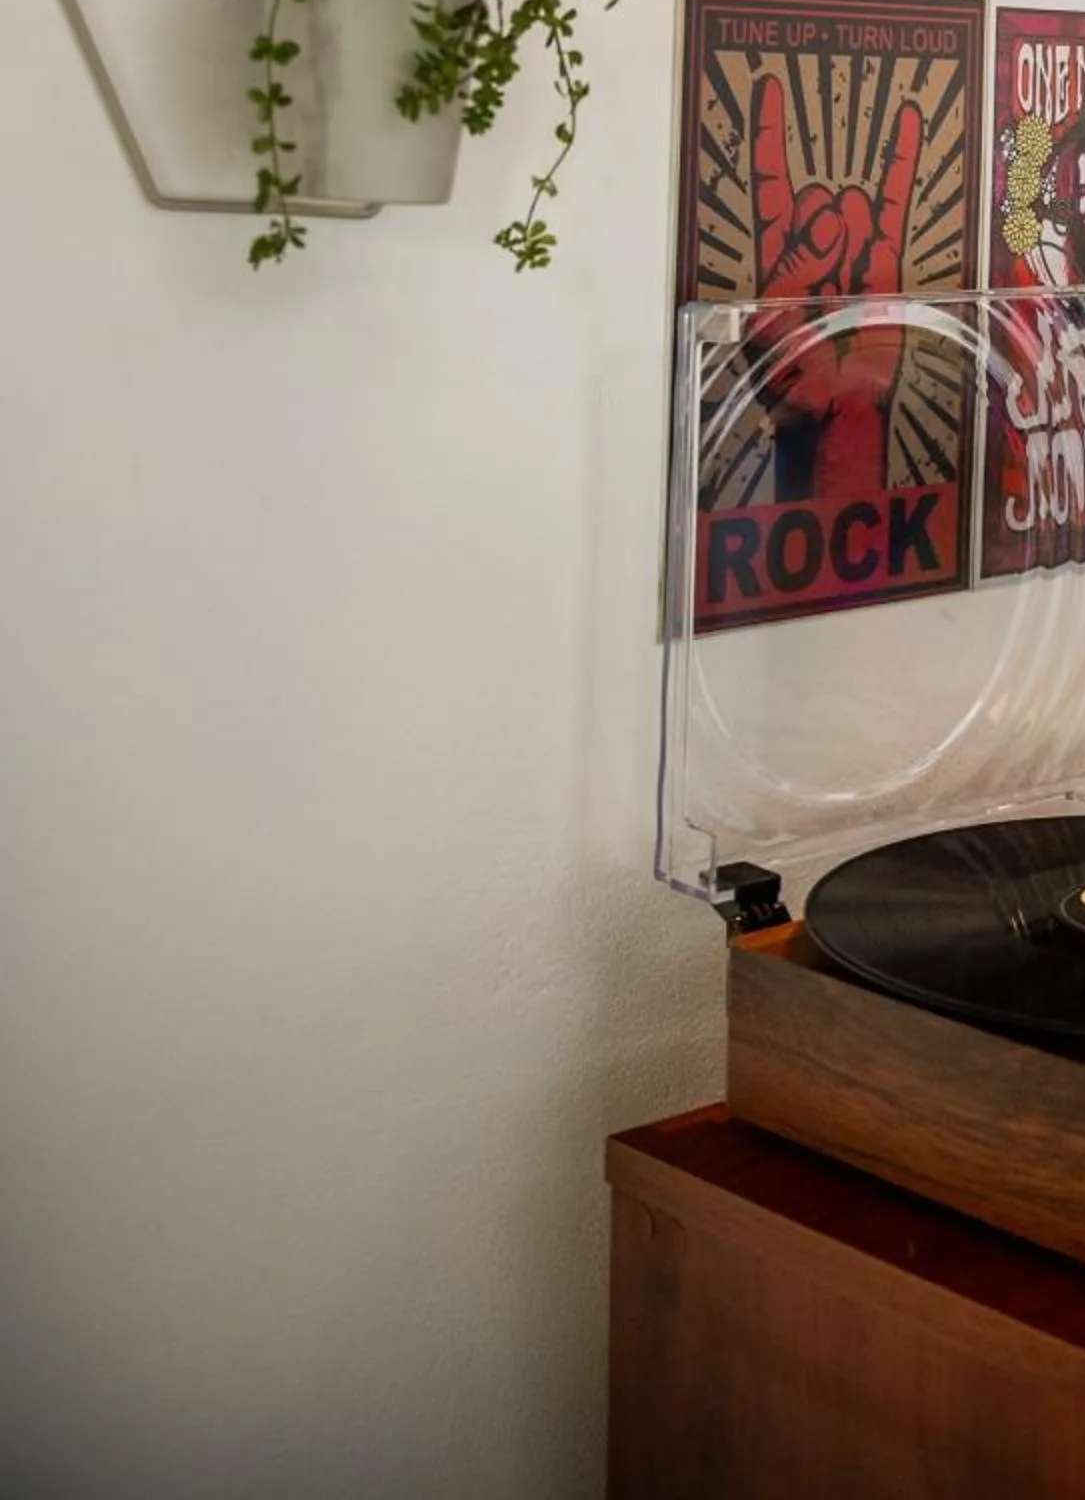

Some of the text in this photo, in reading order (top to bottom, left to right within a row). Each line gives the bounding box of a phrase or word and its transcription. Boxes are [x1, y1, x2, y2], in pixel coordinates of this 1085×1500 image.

[717, 19, 958, 52] TUNE UP TURN LOUD
[1017, 44, 1071, 125] ONE
[706, 494, 941, 604] ROCK
